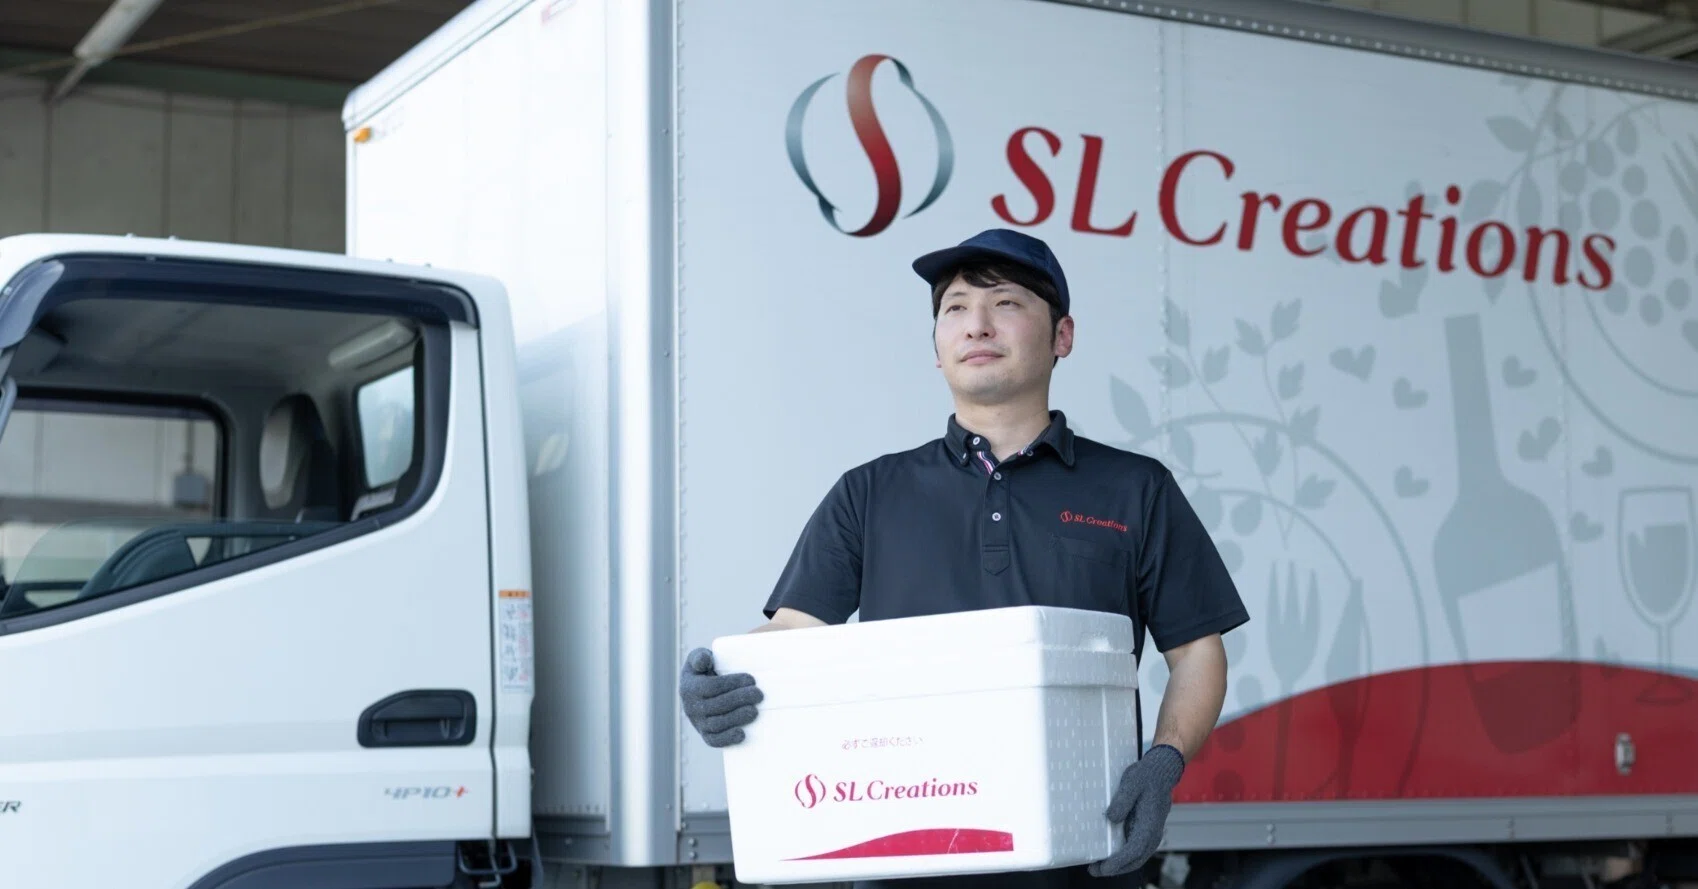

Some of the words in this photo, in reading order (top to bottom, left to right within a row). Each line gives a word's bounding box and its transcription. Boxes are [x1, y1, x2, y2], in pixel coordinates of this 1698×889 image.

[991, 126, 1138, 238] SL
[1158, 150, 1618, 292] Creations
[1073, 514, 1085, 523] SL
[1086, 516, 1128, 532] Creations
[833, 781, 863, 802] SL
[866, 777, 978, 801] Creations
